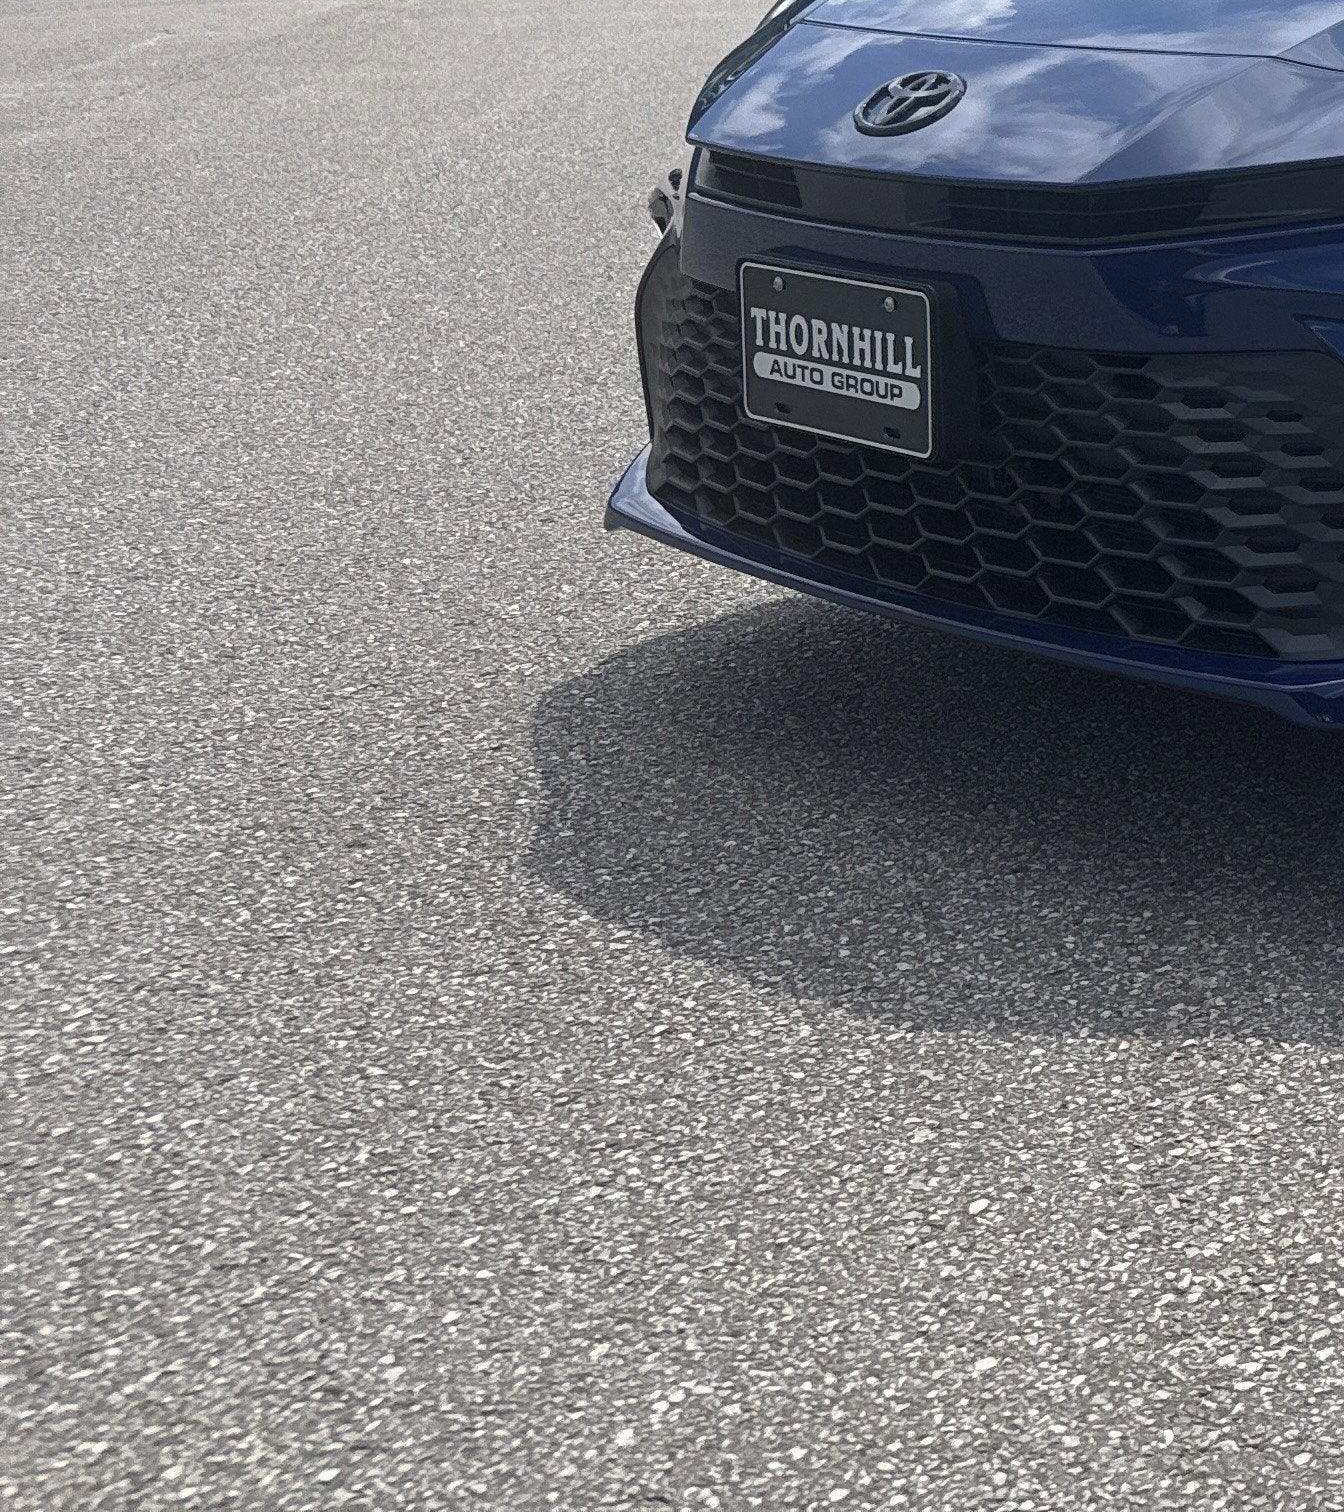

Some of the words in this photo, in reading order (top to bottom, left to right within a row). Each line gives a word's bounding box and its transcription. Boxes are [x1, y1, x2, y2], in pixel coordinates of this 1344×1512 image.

[750, 307, 922, 378] THORNHILL
[769, 359, 824, 386] AUTO
[831, 372, 903, 402] GROUP
